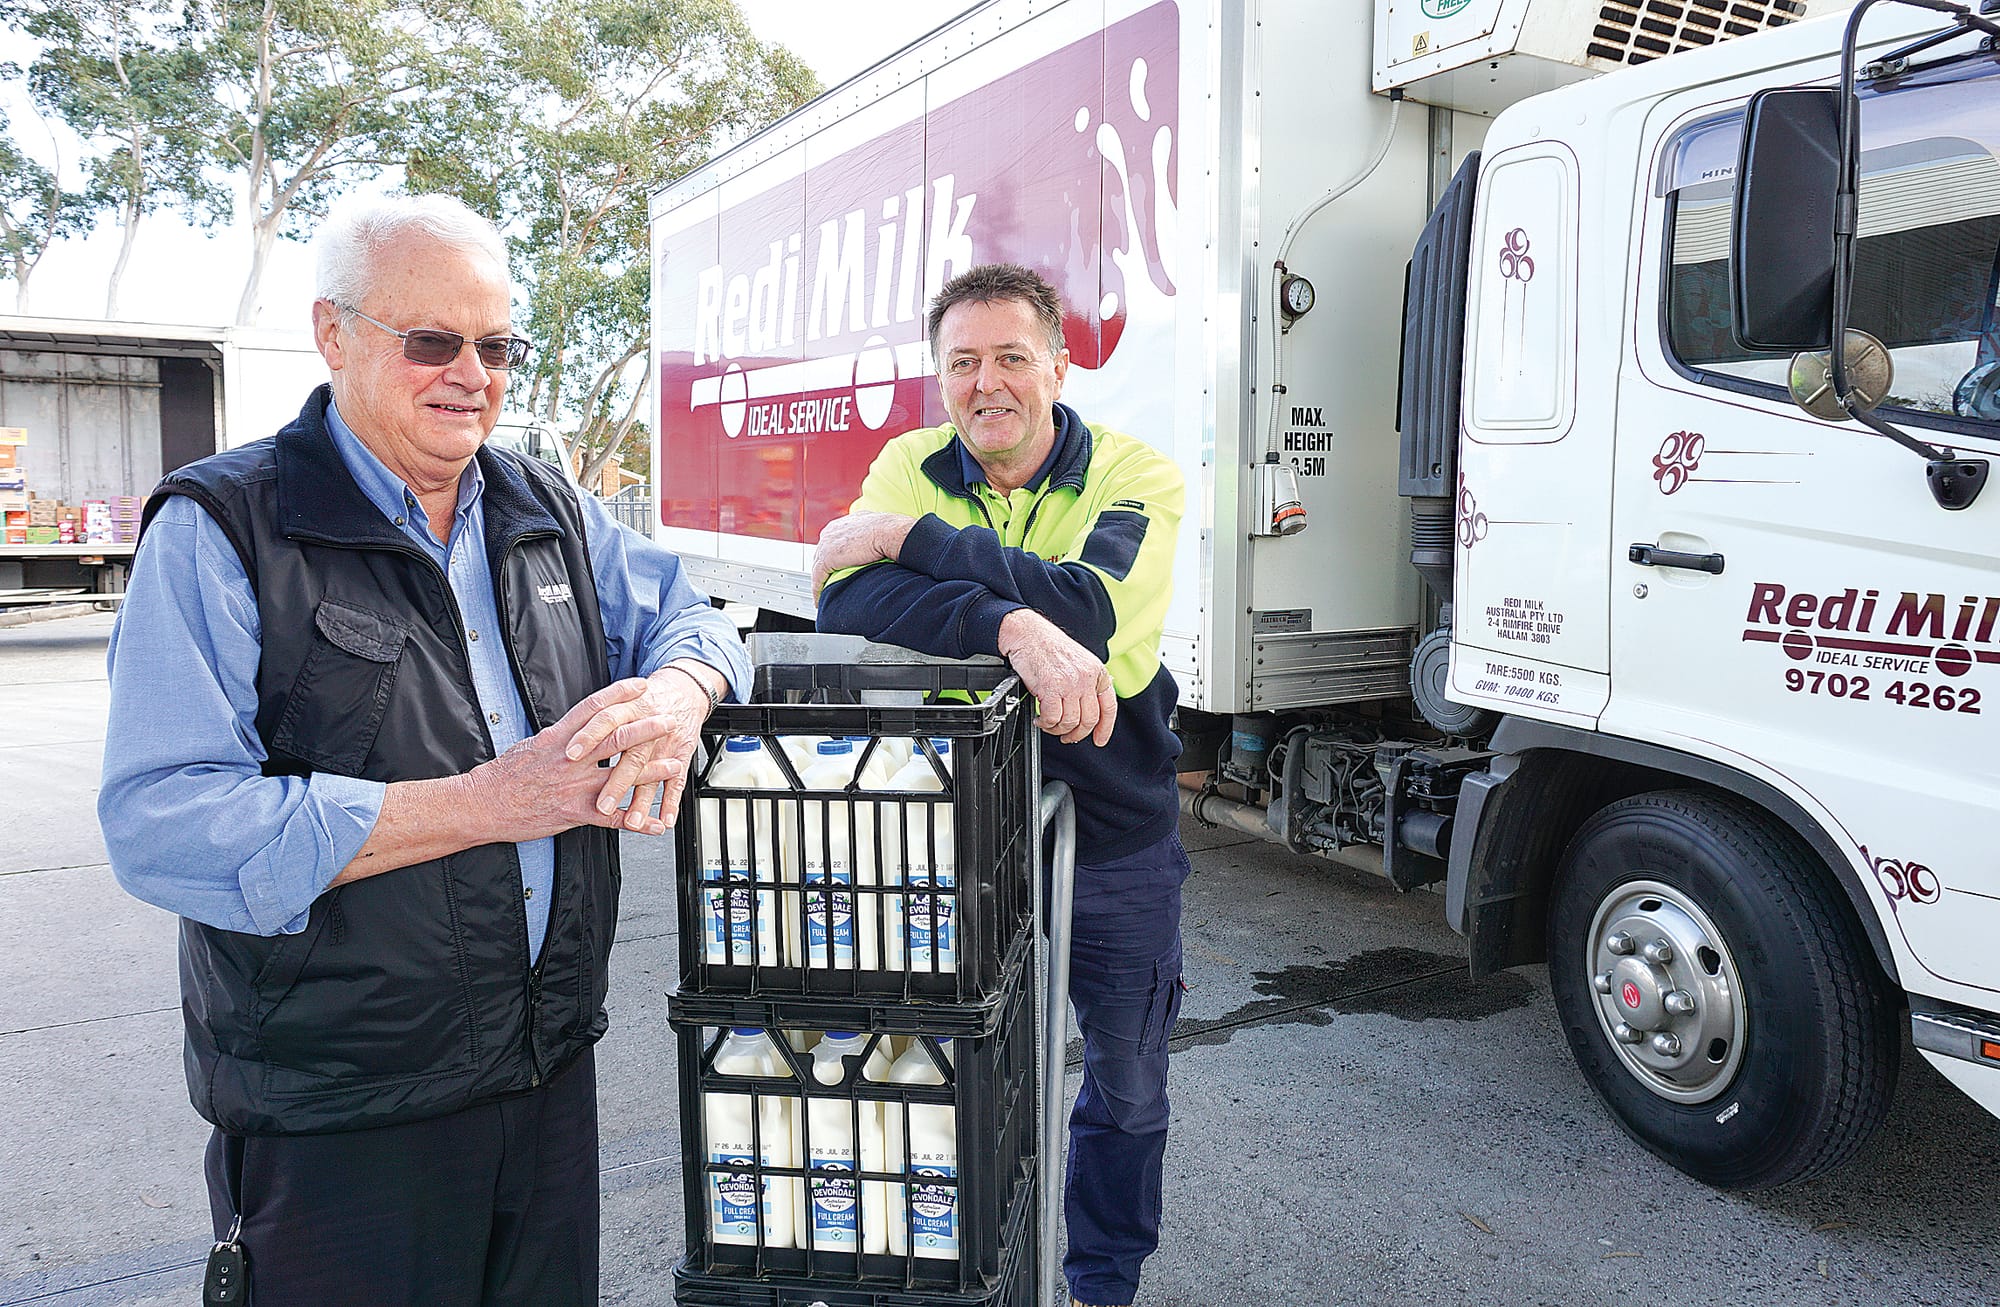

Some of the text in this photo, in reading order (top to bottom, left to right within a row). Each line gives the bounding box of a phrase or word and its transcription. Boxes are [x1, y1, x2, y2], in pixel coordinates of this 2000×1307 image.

[1702, 167, 1734, 178] HIN
[693, 174, 977, 367] Redi Milk
[747, 396, 852, 437] IDEAL SERVICE
[1291, 407, 1326, 427] MAX.
[1284, 432, 1333, 452] HEIGHT
[1503, 597, 1544, 610] REDI MILK
[1486, 606, 1564, 623] AUSTRALIA PTY LTD
[1747, 583, 2000, 643] Redi Mil
[1488, 617, 1561, 634] 2-4 RIMFIRE DRIVE
[1497, 629, 1551, 644] HALLAM 3803
[1816, 651, 1930, 674] IDEAL SERVICE
[1486, 662, 1562, 687] TARE:5500 KGS.
[1475, 679, 1560, 704] GVM: 10400 KGS.
[1785, 668, 1982, 715] 9702 4262
[807, 902, 852, 912] DEVODALE
[720, 1182, 754, 1192] DEVONDA
[724, 1207, 755, 1215] FULL CREA
[817, 1212, 854, 1221] FULL CREAM
[913, 1216, 949, 1228] FULL CREAM
